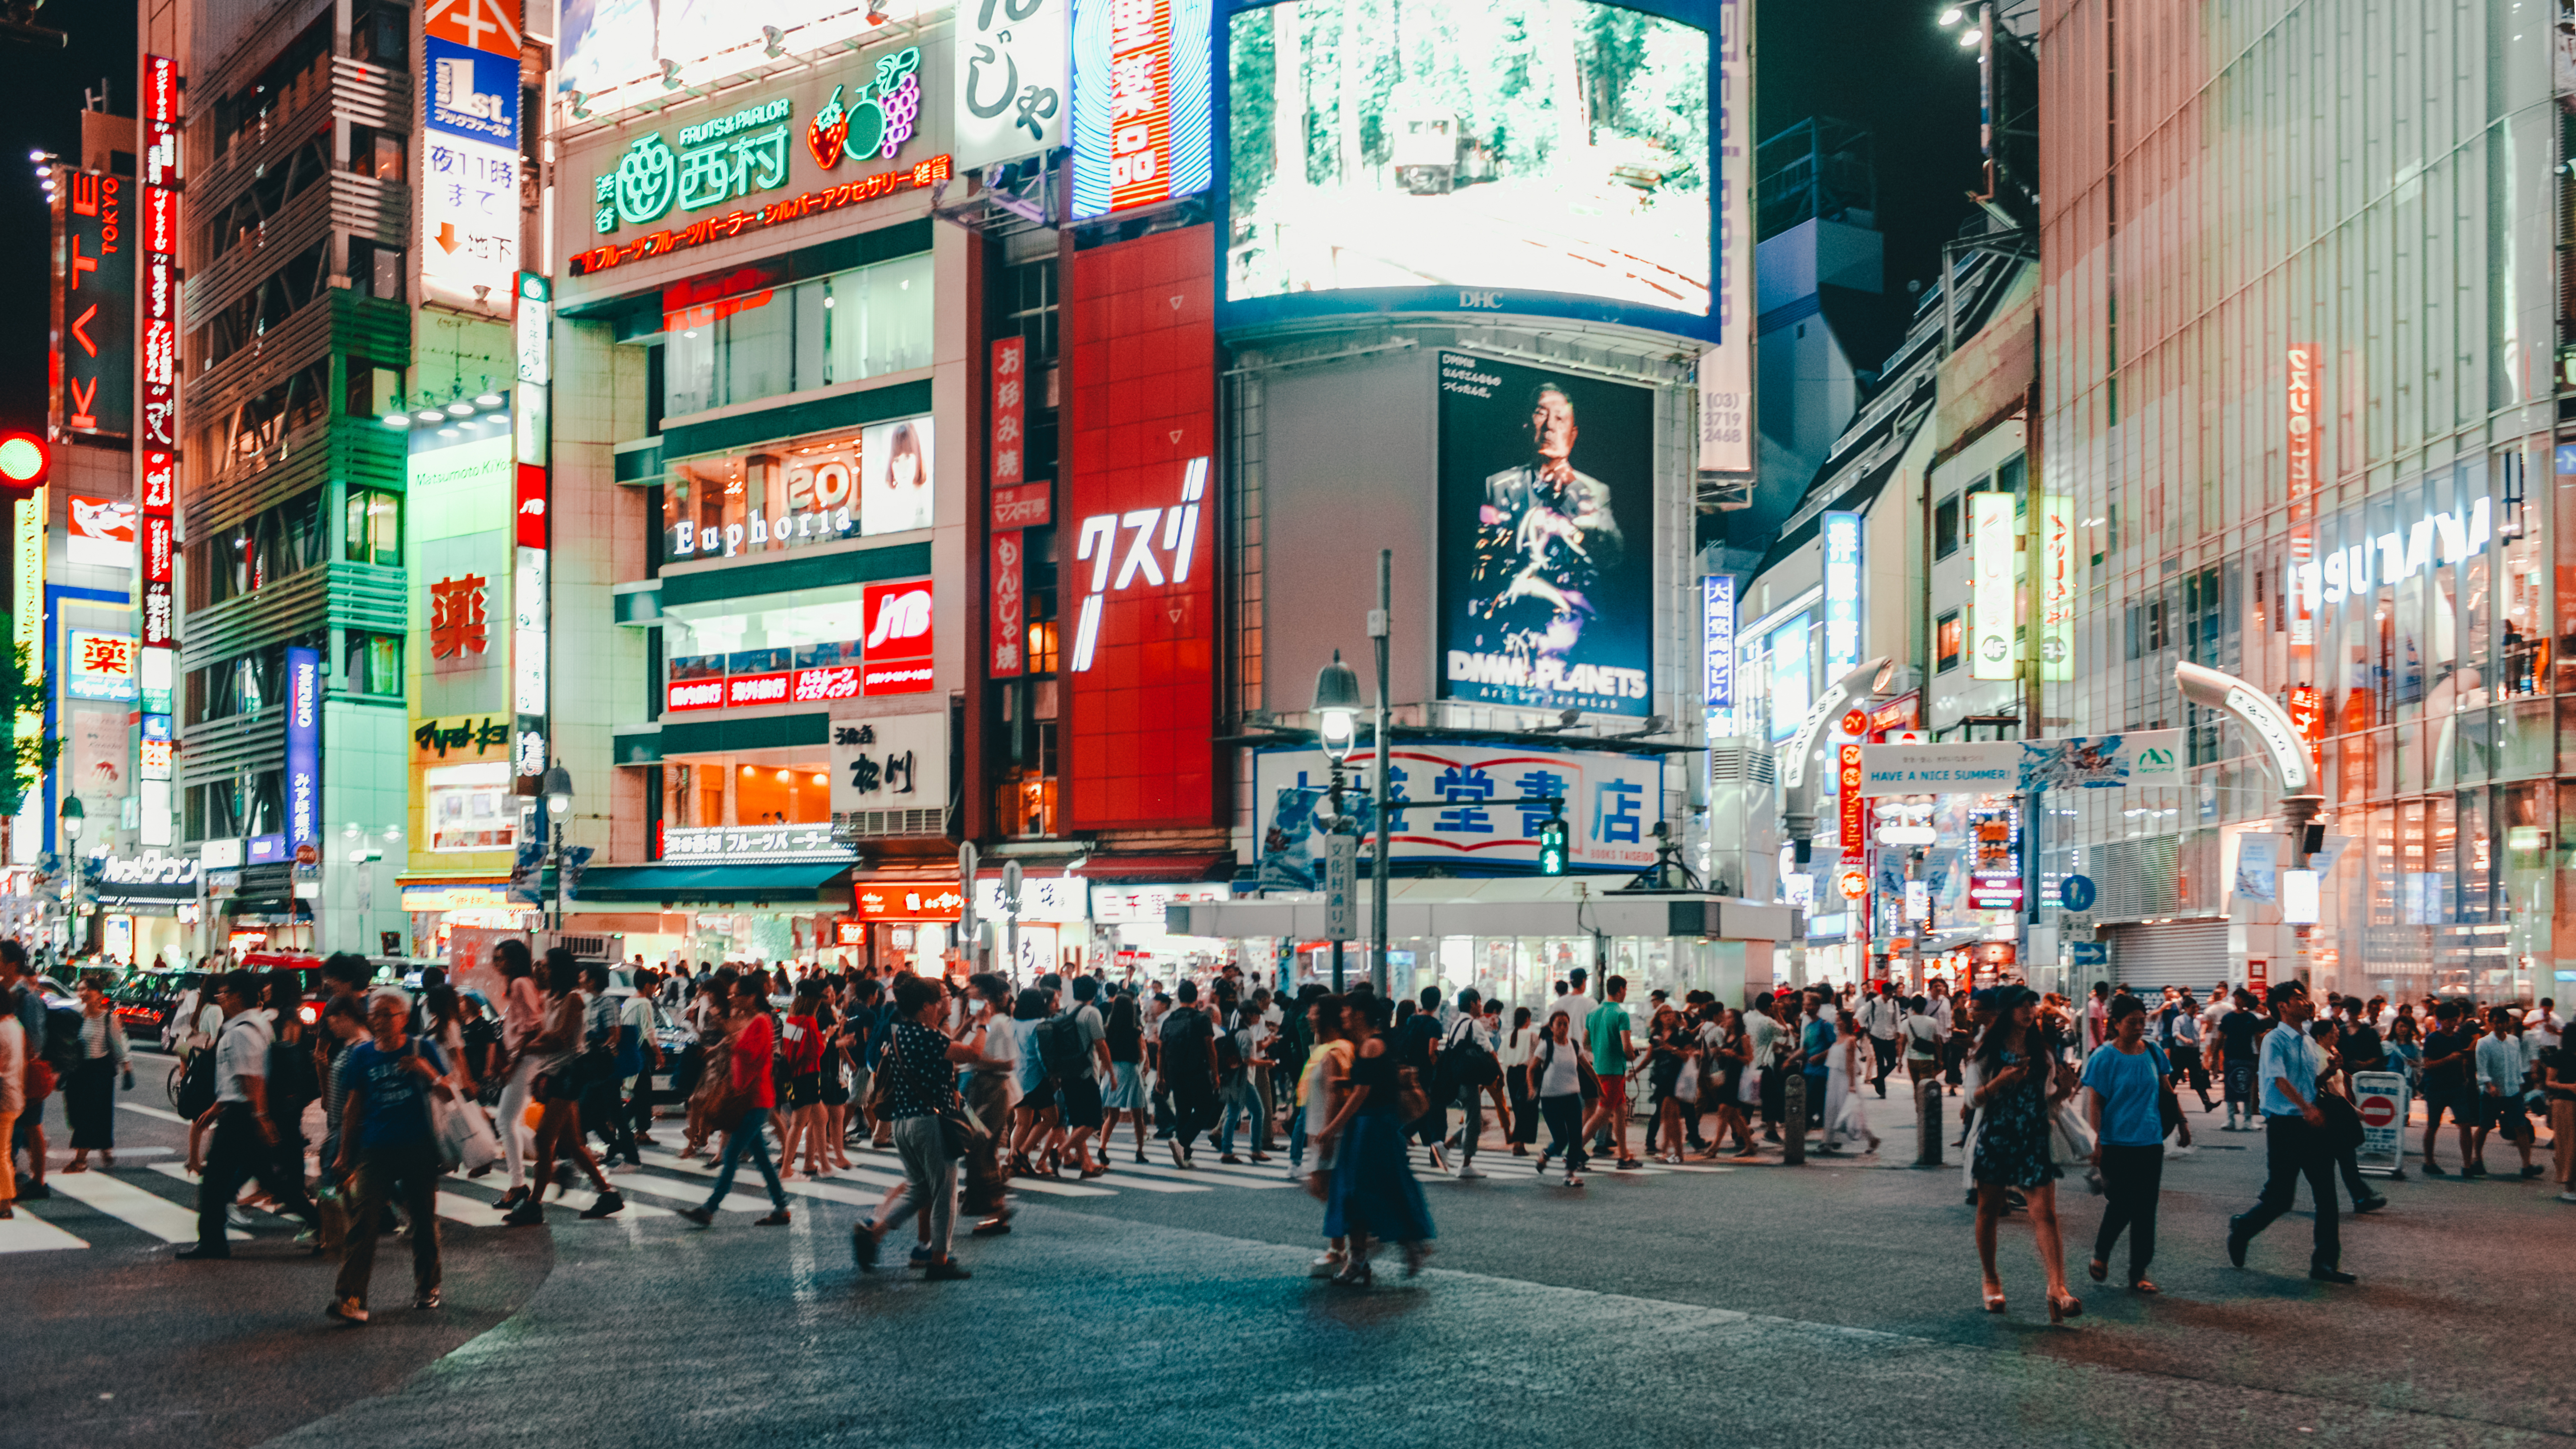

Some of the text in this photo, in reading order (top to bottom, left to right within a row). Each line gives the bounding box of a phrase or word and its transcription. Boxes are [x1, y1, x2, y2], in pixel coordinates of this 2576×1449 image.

[435, 62, 451, 103] BOOK
[434, 107, 513, 138] ブックファースト
[431, 145, 512, 189] 夜11時
[678, 124, 788, 210] 西村
[101, 177, 119, 255] TOKYO
[595, 174, 615, 233] 渋谷
[468, 230, 512, 263] 地下
[1459, 291, 1504, 309] DHC
[1707, 392, 1740, 409] (03)
[1704, 412, 1742, 427] 3719
[1704, 429, 1742, 443] 2468
[415, 467, 479, 488] Matsumoto
[519, 498, 545, 515] JTB
[674, 501, 852, 557] Euphoria
[430, 572, 490, 660] 薬
[866, 589, 933, 649] JTB
[83, 637, 127, 674] 薬
[1981, 637, 2006, 659] 4F
[731, 678, 787, 702] 海外旅行
[1448, 650, 1647, 699] DMM PLANETS
[850, 749, 914, 795] 松川
[1871, 771, 1903, 781] HAVE
[1908, 771, 1915, 781] A
[1920, 770, 1949, 781] NICE
[725, 831, 832, 851] フルーツパーラー
